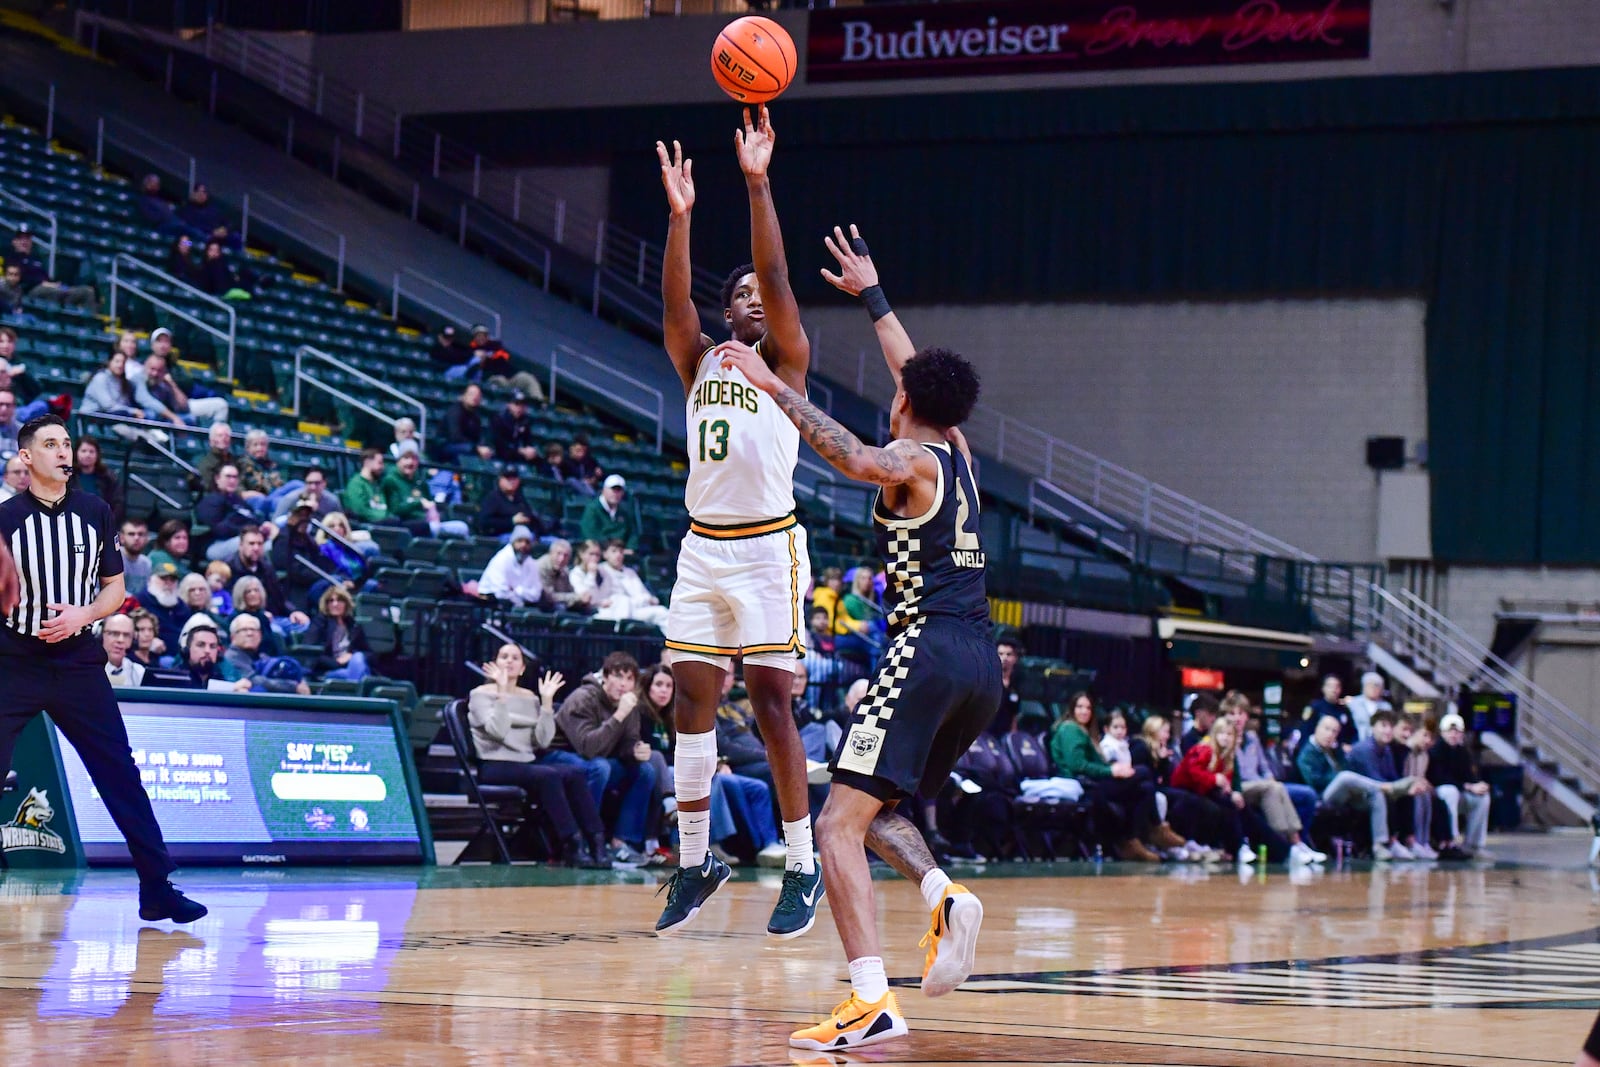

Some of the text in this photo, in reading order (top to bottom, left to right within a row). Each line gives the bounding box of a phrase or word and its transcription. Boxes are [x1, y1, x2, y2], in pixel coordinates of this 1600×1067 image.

[842, 16, 1069, 62] Budweiser
[1085, 6, 1212, 55] Brew
[718, 49, 757, 85] ELITE
[698, 419, 730, 462] 13
[954, 476, 980, 550] 2
[73, 545, 86, 553] TW
[149, 753, 166, 765] on
[168, 751, 189, 766] the
[191, 754, 223, 767] same
[286, 742, 313, 761] SAY
[160, 766, 170, 783] it
[172, 771, 212, 784] comes
[214, 770, 228, 784] to
[157, 785, 201, 803] healing
[2, 826, 64, 851] WRIGHT STATE
